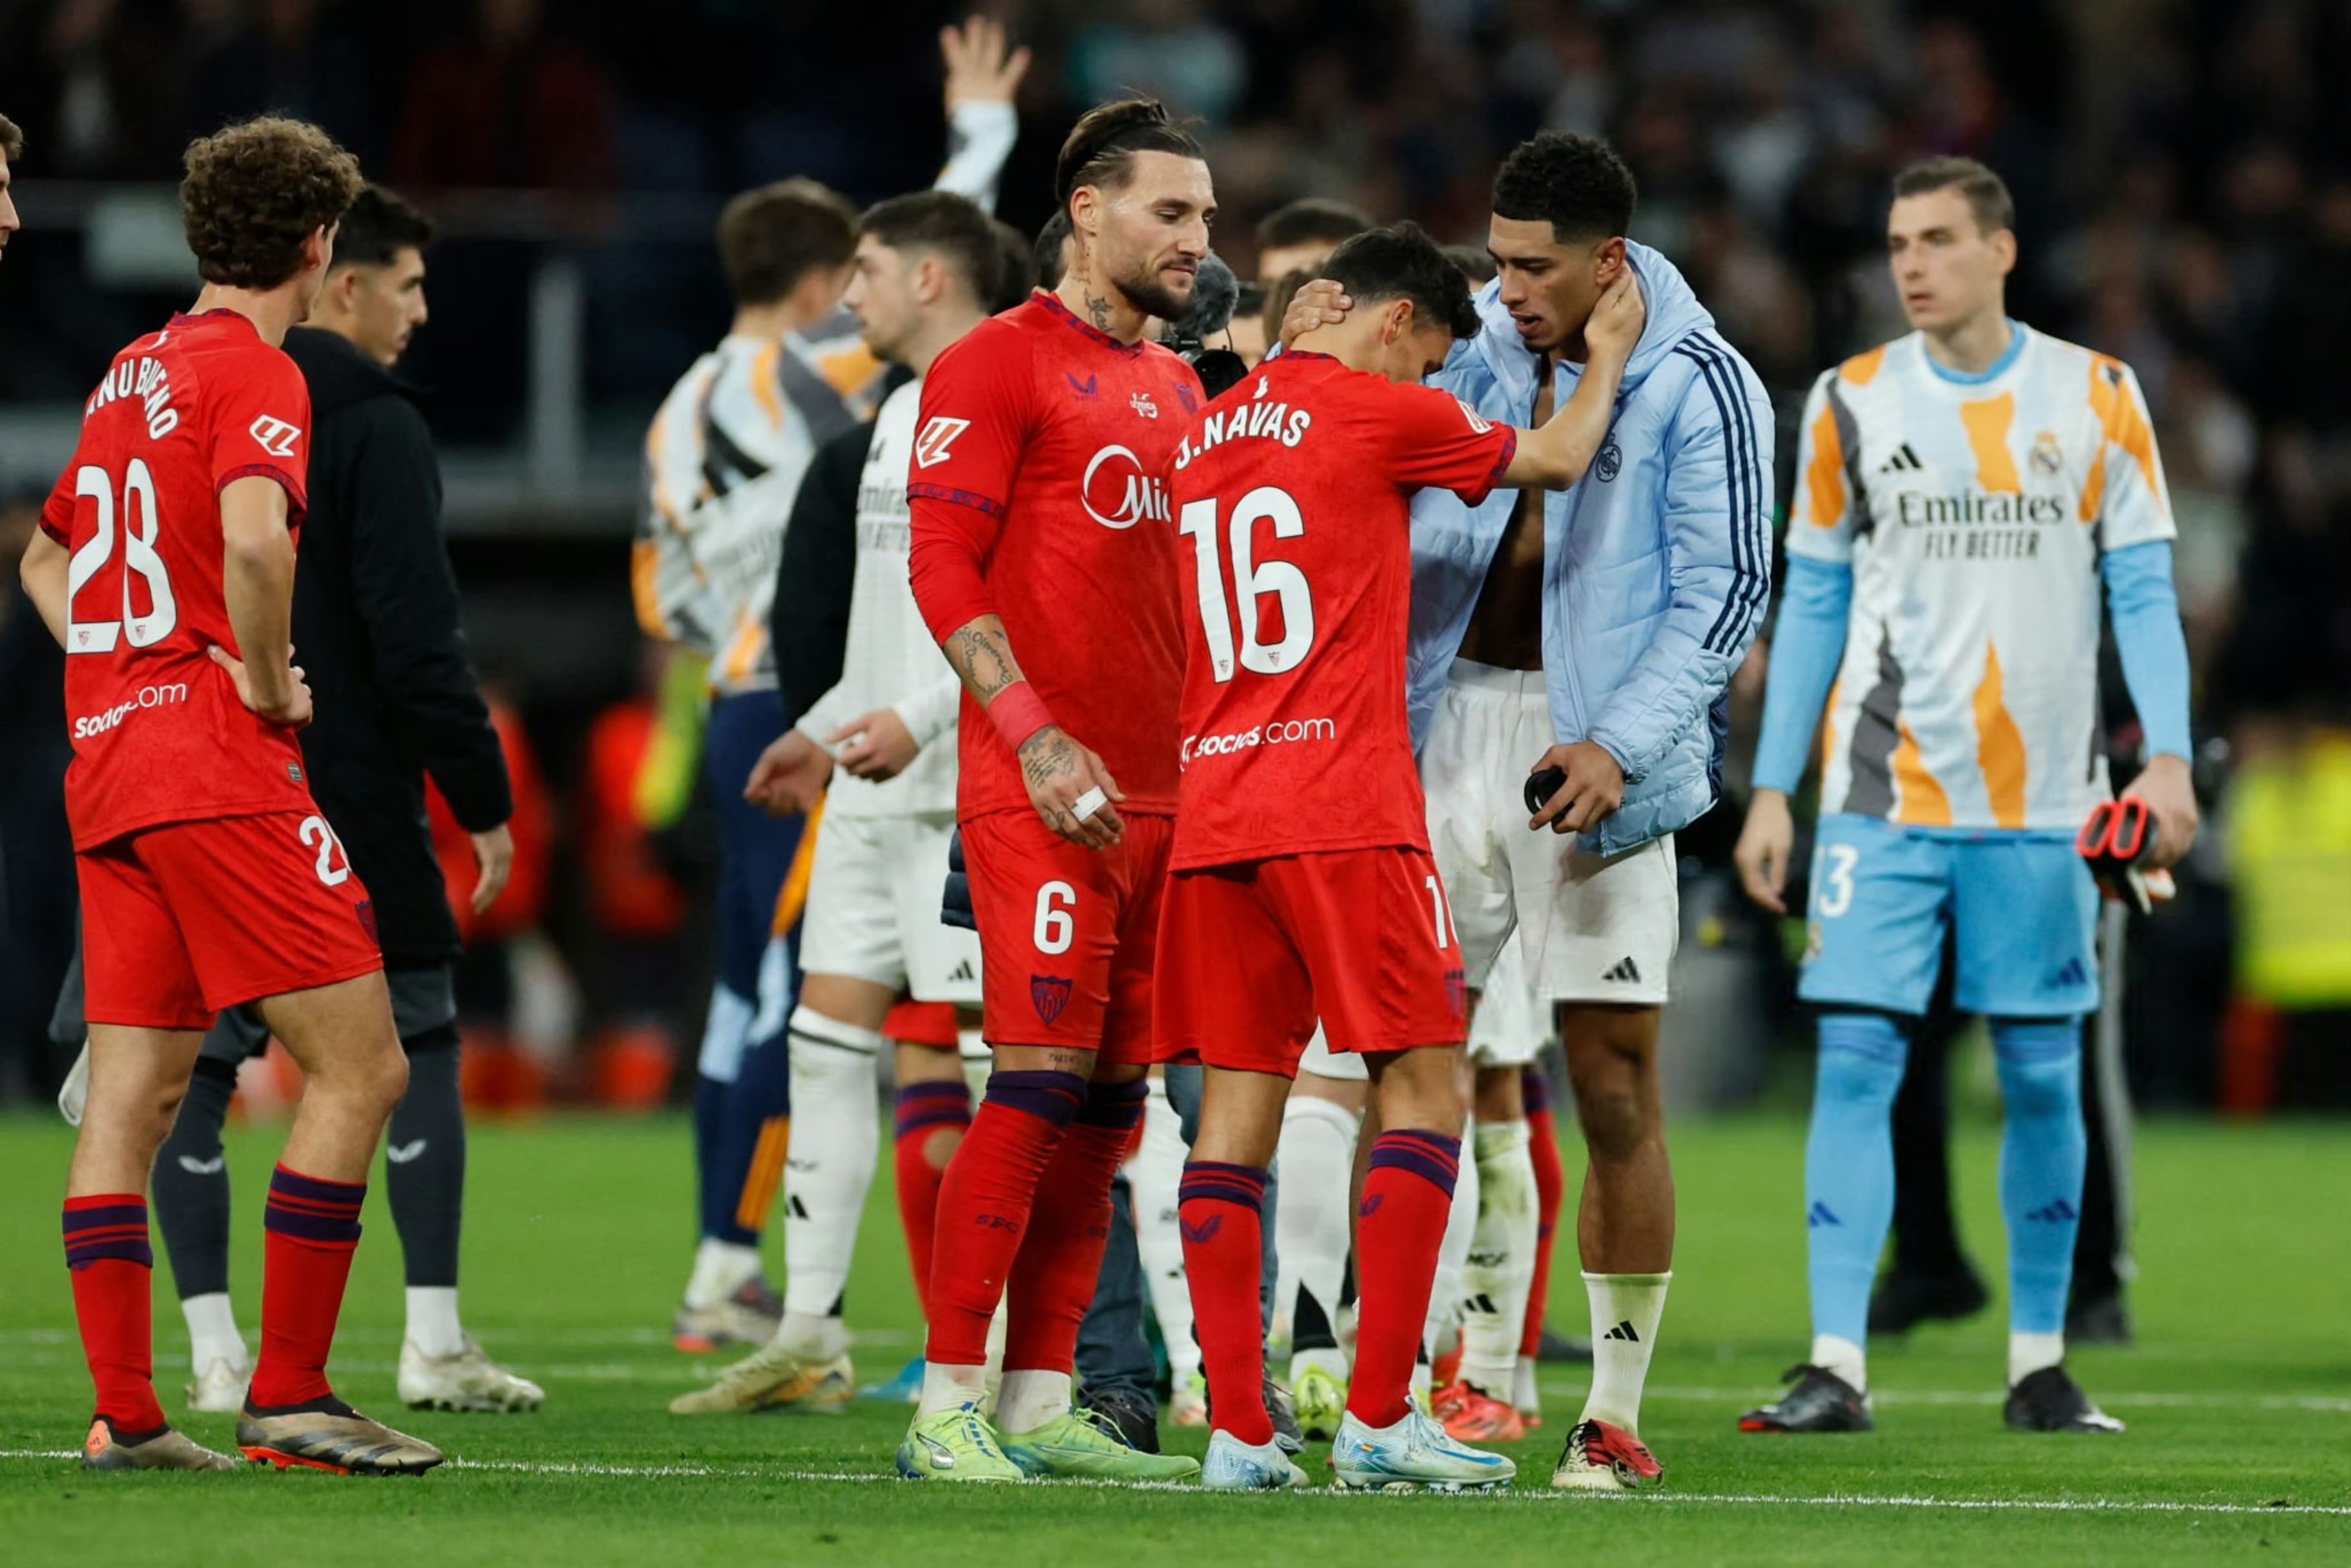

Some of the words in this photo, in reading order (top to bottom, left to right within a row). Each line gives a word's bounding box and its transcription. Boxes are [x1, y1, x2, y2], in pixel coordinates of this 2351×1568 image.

[1175, 401, 1311, 469] J.NAVAS
[1899, 487, 2064, 529] Emirates
[66, 457, 177, 654] 28
[1925, 531, 1957, 559] FLY
[1966, 531, 2040, 559] BETTER
[1179, 486, 1314, 684] 16
[299, 815, 351, 886] 2
[1033, 880, 1077, 955] 6
[1425, 874, 1459, 950] 1
